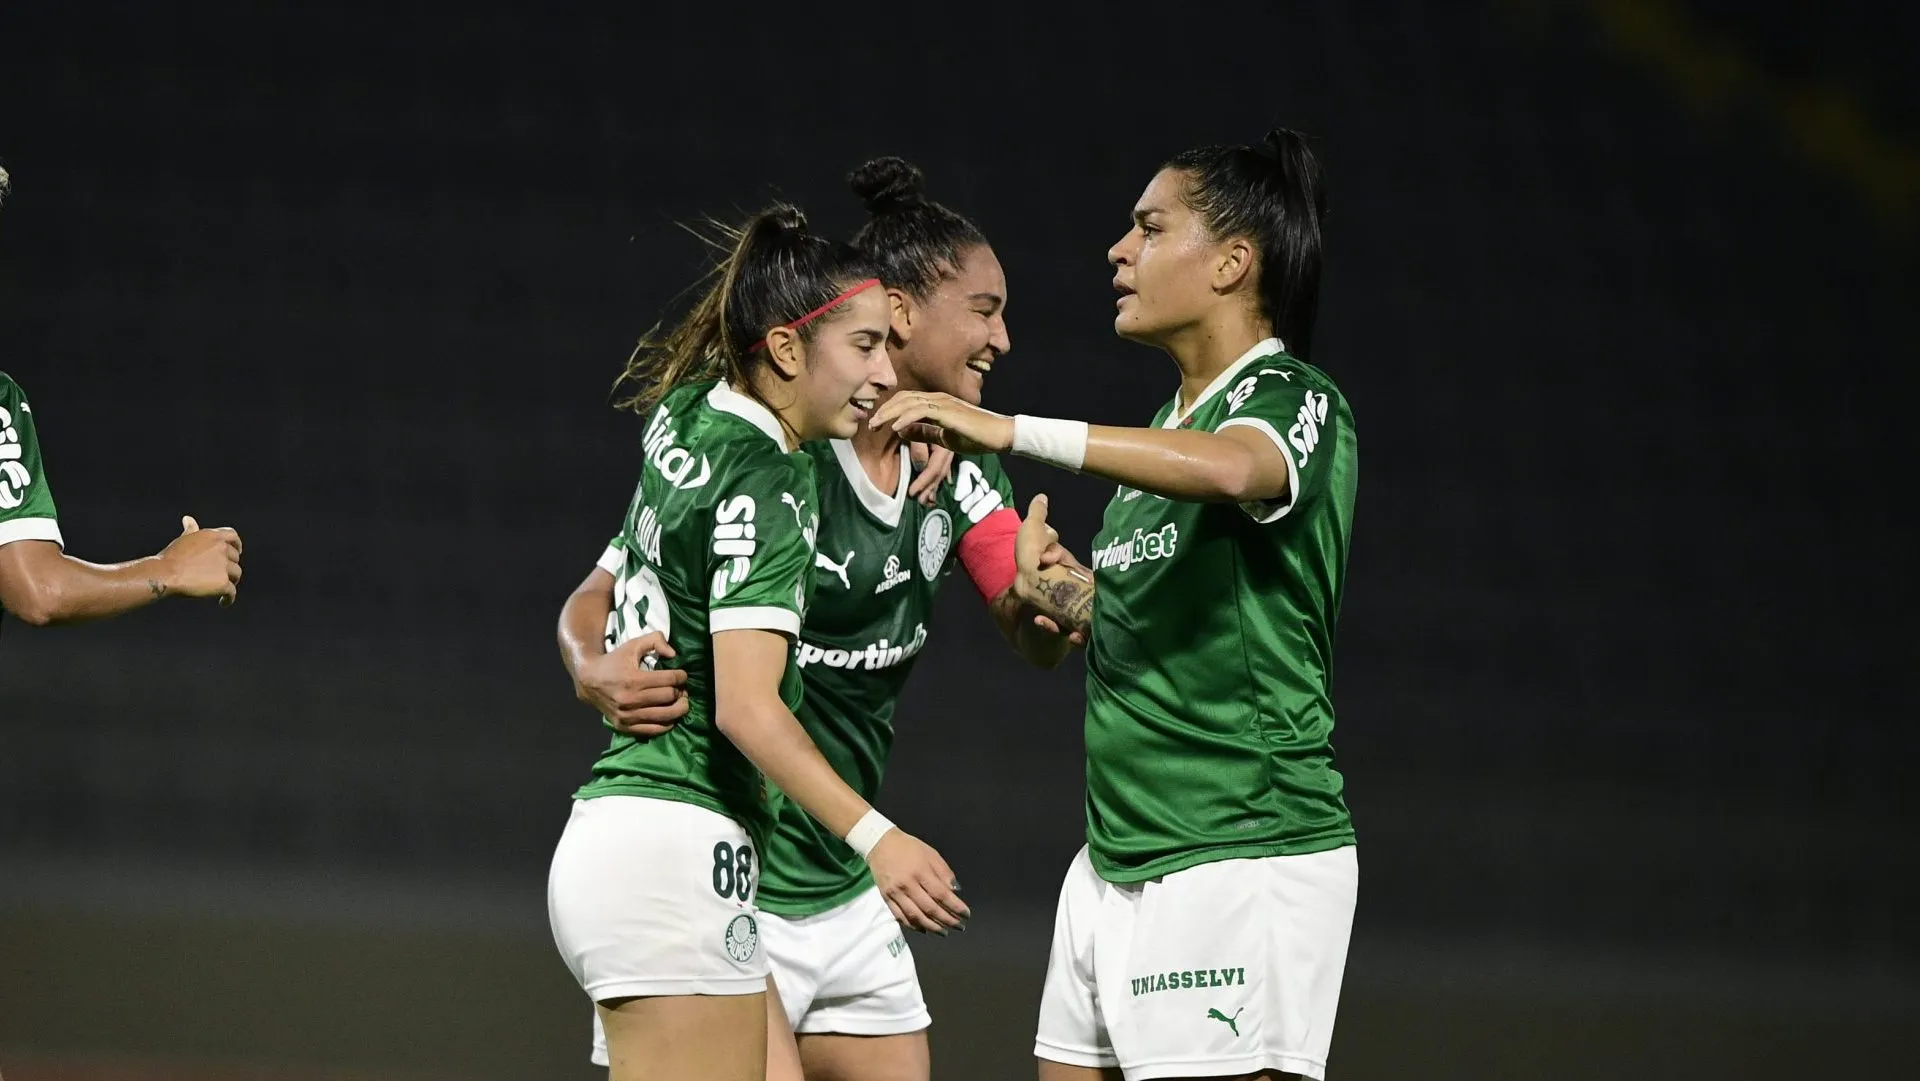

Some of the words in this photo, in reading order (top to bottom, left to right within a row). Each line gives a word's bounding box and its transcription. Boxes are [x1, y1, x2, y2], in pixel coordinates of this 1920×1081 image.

[1092, 522, 1178, 572] rtingbet
[713, 841, 752, 902] 88
[1131, 967, 1245, 996] UNIASSELVI
